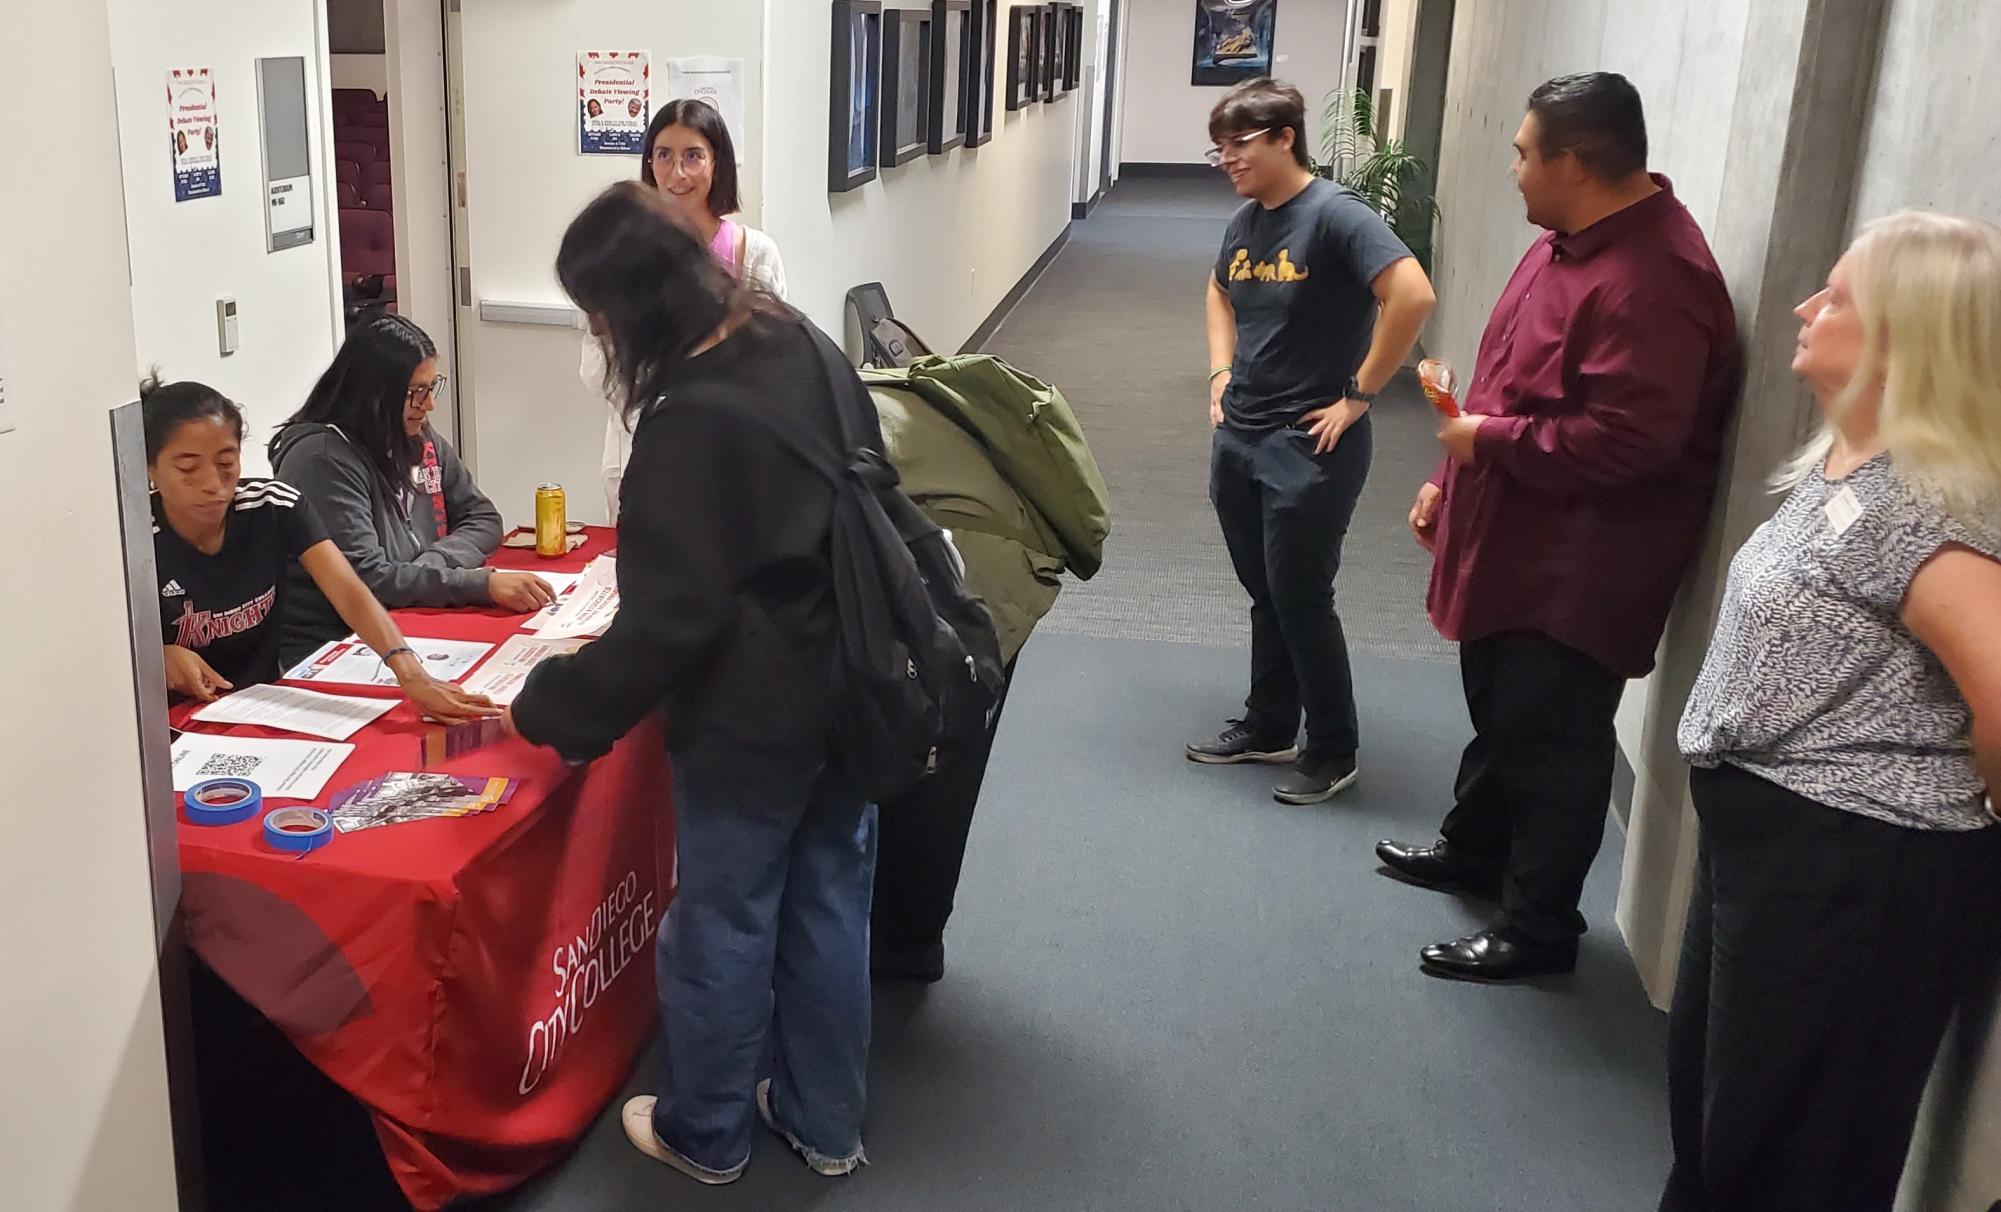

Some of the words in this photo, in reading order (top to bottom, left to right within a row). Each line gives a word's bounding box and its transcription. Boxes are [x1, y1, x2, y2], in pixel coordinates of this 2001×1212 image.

[614, 88, 640, 96] Viewing
[161, 588, 186, 597] adidas
[552, 925, 590, 998] SAN
[590, 870, 637, 953] DIEGO
[518, 991, 570, 1095] CITY
[569, 890, 656, 1035] COLLEGE
